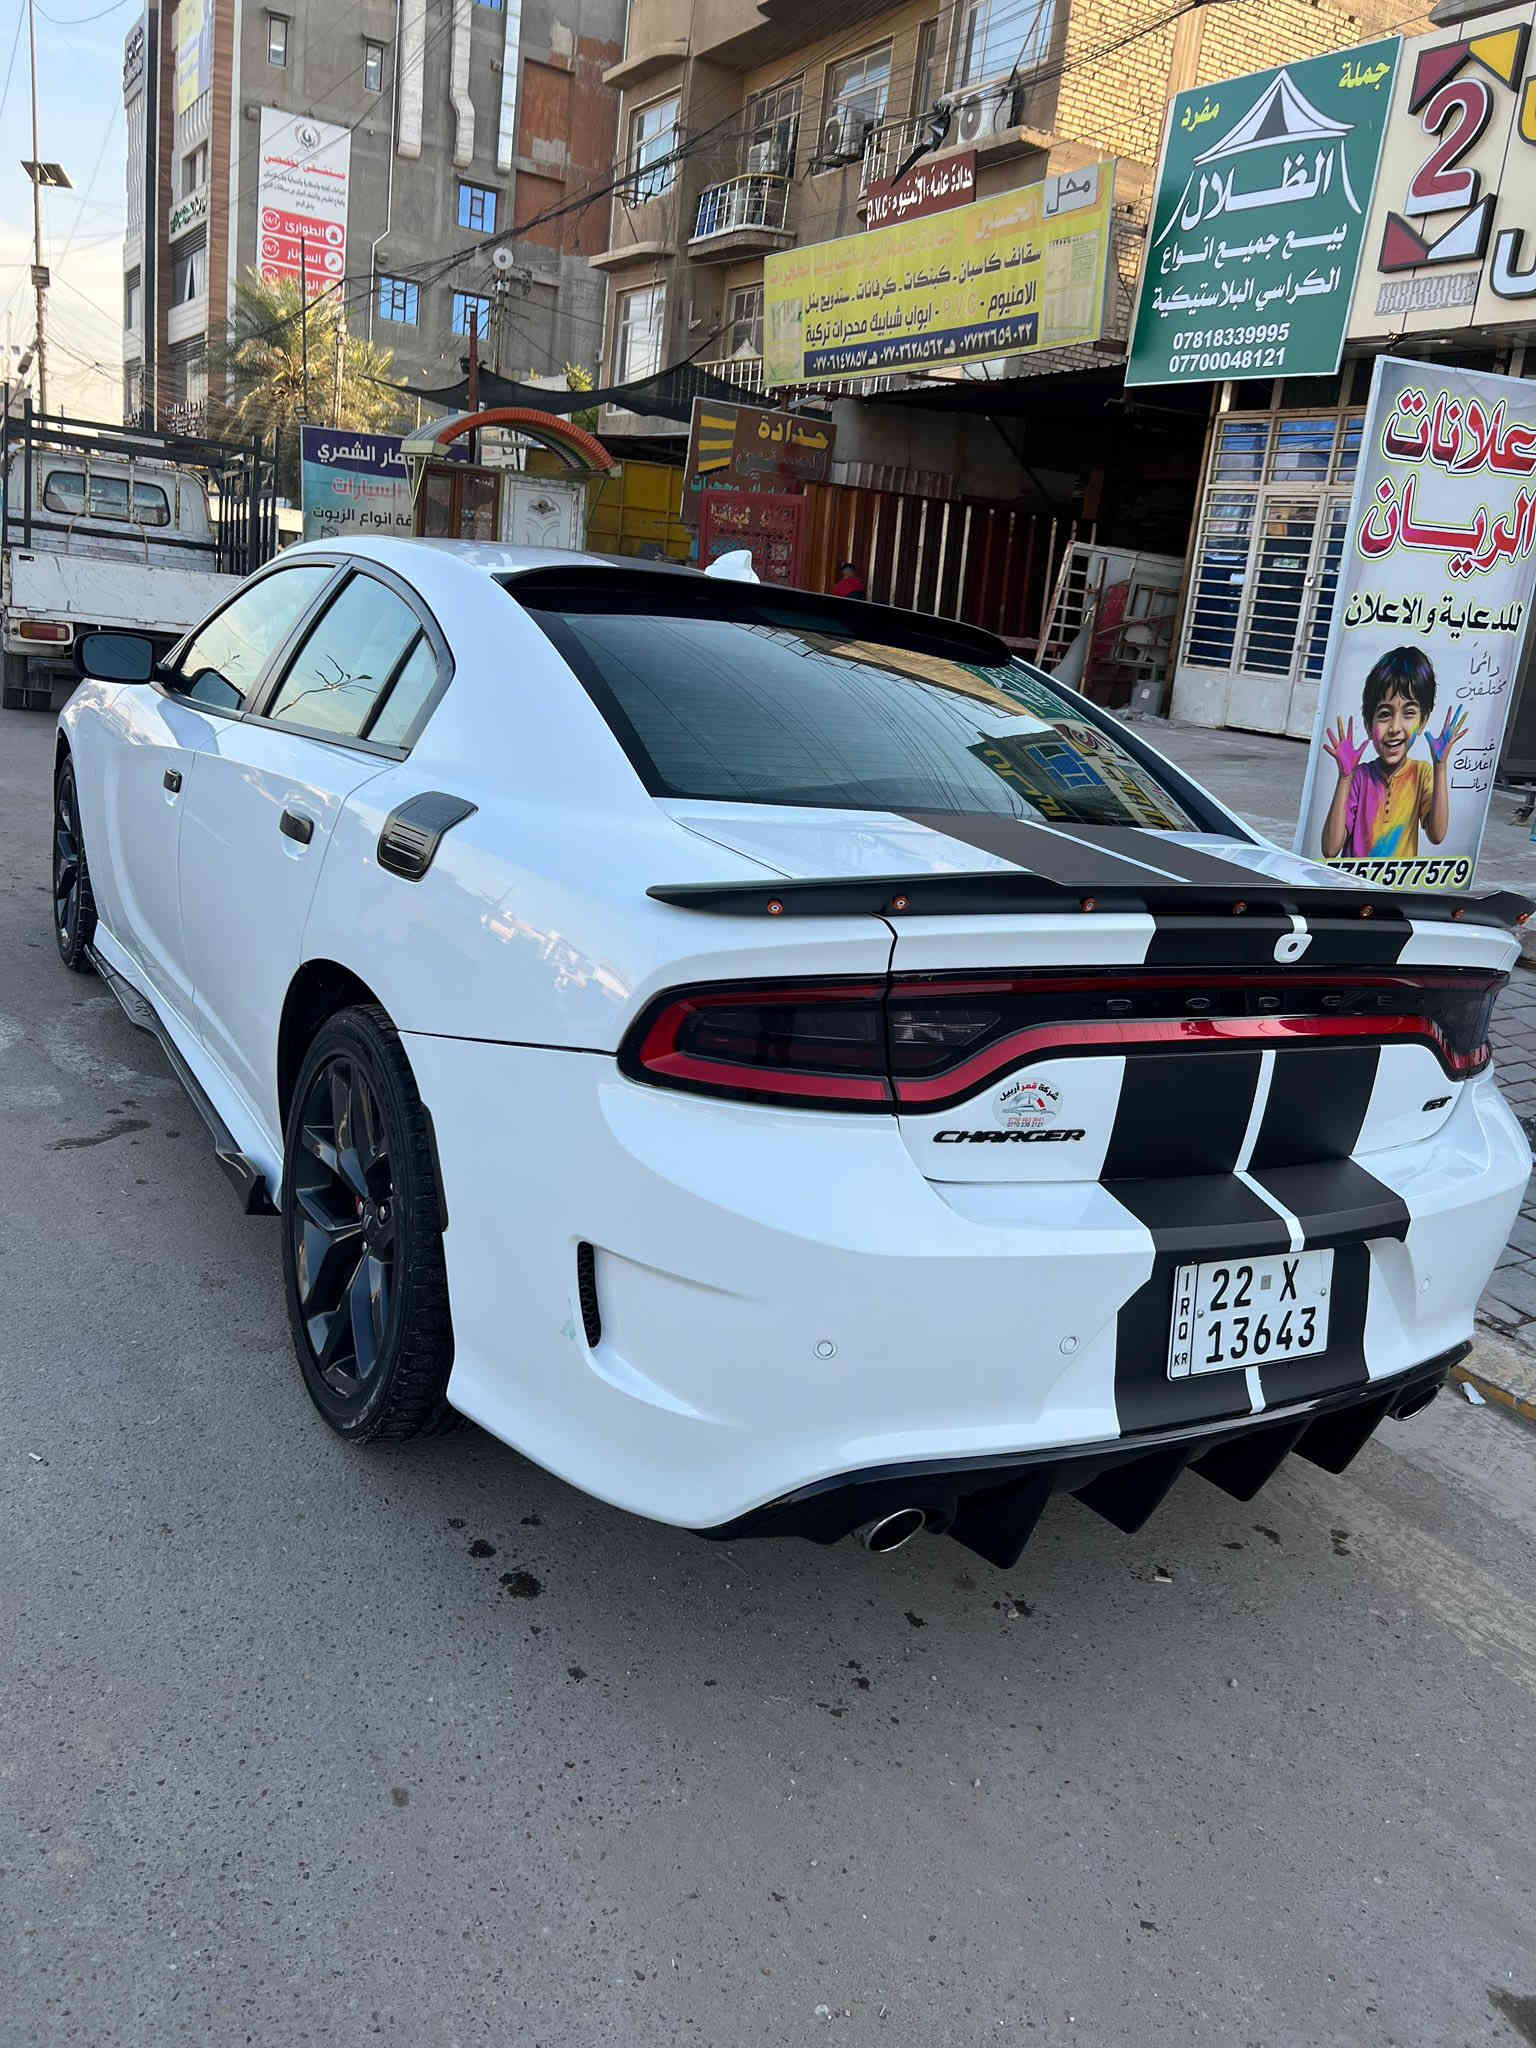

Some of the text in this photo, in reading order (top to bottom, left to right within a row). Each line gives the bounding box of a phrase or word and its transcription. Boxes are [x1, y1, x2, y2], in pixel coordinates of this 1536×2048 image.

[1339, 61, 1390, 89] جملة
[1181, 97, 1220, 132] مفرد
[1046, 176, 1091, 214] محل
[1180, 148, 1335, 231] الظلال
[1160, 223, 1347, 274] بيع جميع انواع
[1152, 277, 1255, 317] البلاستيكية
[1255, 266, 1341, 311] الكراسي
[833, 320, 867, 344] محجرات
[870, 305, 902, 336] شبابيك
[905, 302, 932, 331] ابواب
[806, 321, 831, 347] تركية
[1172, 322, 1291, 350] 07818339995
[1168, 347, 1287, 373] 07700048121
[758, 415, 830, 450] حدادة
[318, 441, 376, 464] الشمري
[1439, 596, 1523, 639] للدعاية
[932, 1128, 1086, 1143] CHARGER
[1210, 1258, 1300, 1312] 22 X
[1206, 1306, 1317, 1364] 13643
[1174, 1352, 1188, 1367] KR
